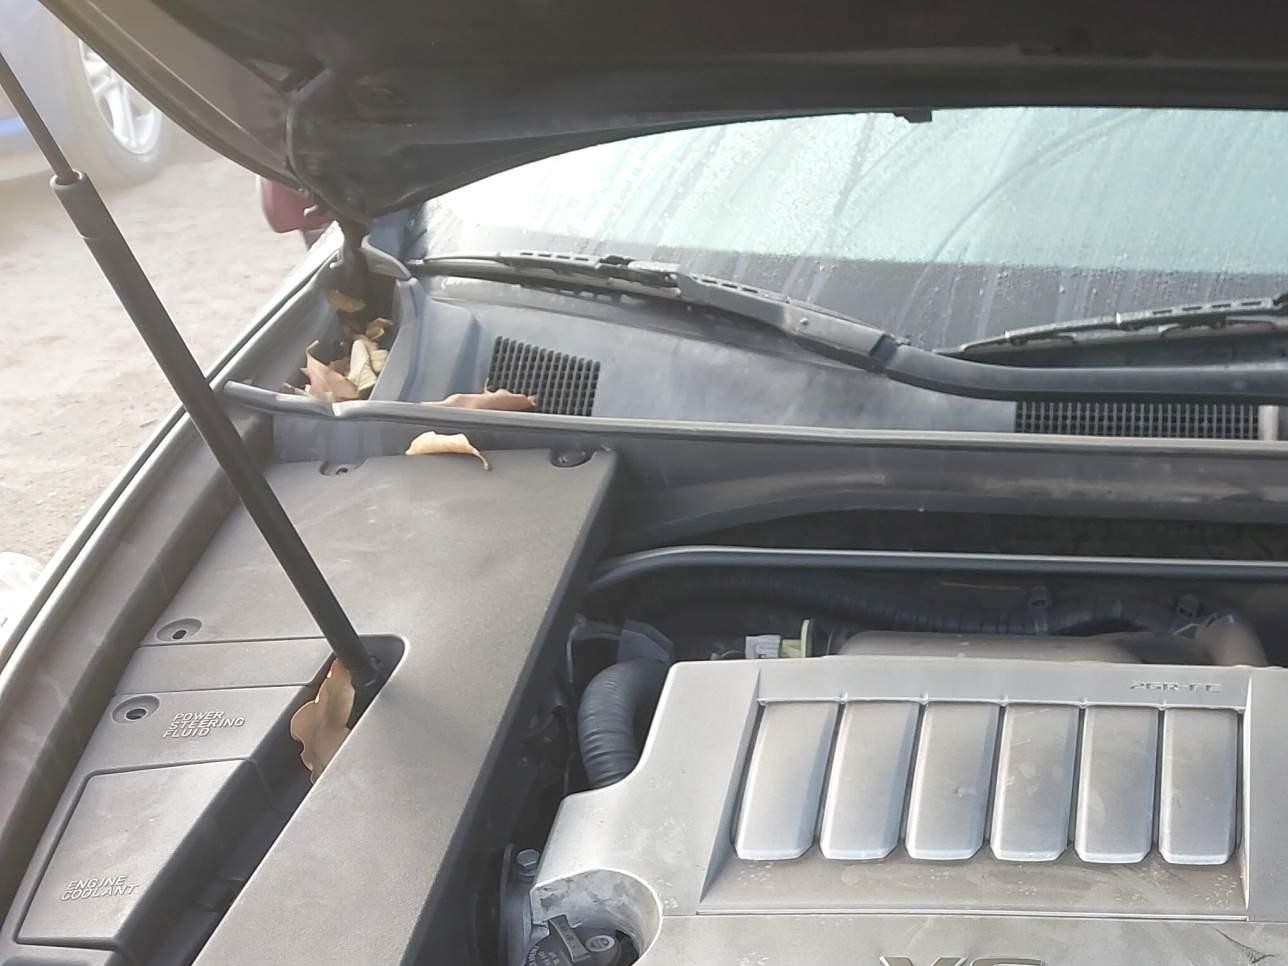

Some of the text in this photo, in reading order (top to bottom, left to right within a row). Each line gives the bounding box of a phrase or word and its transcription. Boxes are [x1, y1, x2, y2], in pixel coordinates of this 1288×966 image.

[173, 711, 225, 722] POWER
[169, 717, 246, 730] STEERING
[162, 727, 210, 739] FLUID
[68, 875, 129, 891] ENGINE
[60, 884, 140, 901] COOLANT
